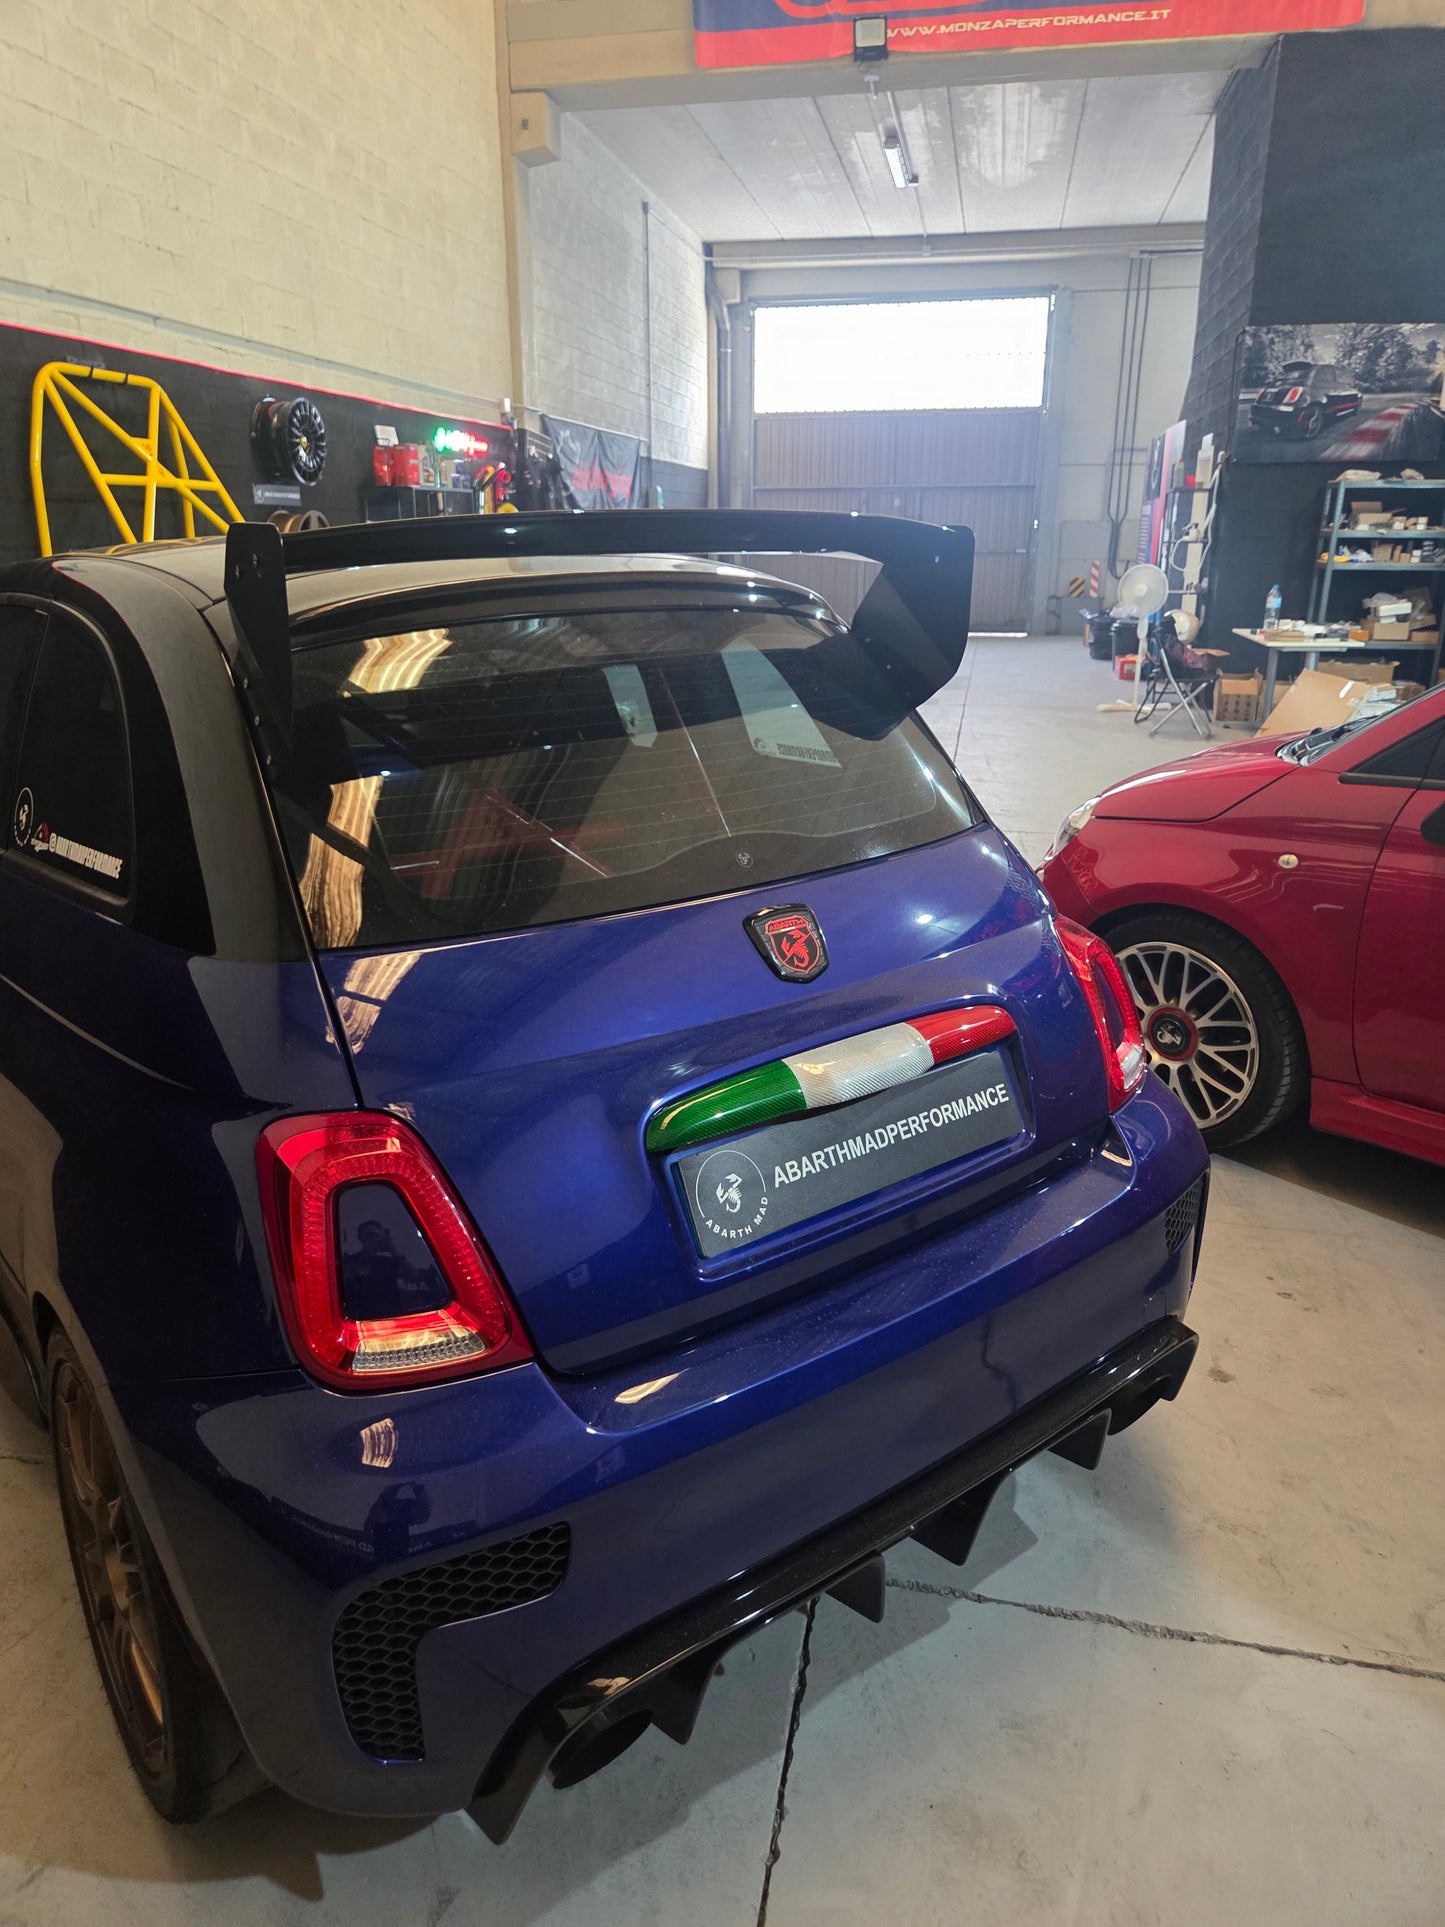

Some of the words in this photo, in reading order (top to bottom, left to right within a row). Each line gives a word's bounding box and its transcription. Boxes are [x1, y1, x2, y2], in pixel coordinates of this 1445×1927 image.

[768, 918, 804, 932] ABARTH
[774, 1083, 1010, 1188] ABARTHMADPERFORMANCE
[705, 1218, 753, 1239] ABARTH
[753, 1196, 768, 1226] MAD
